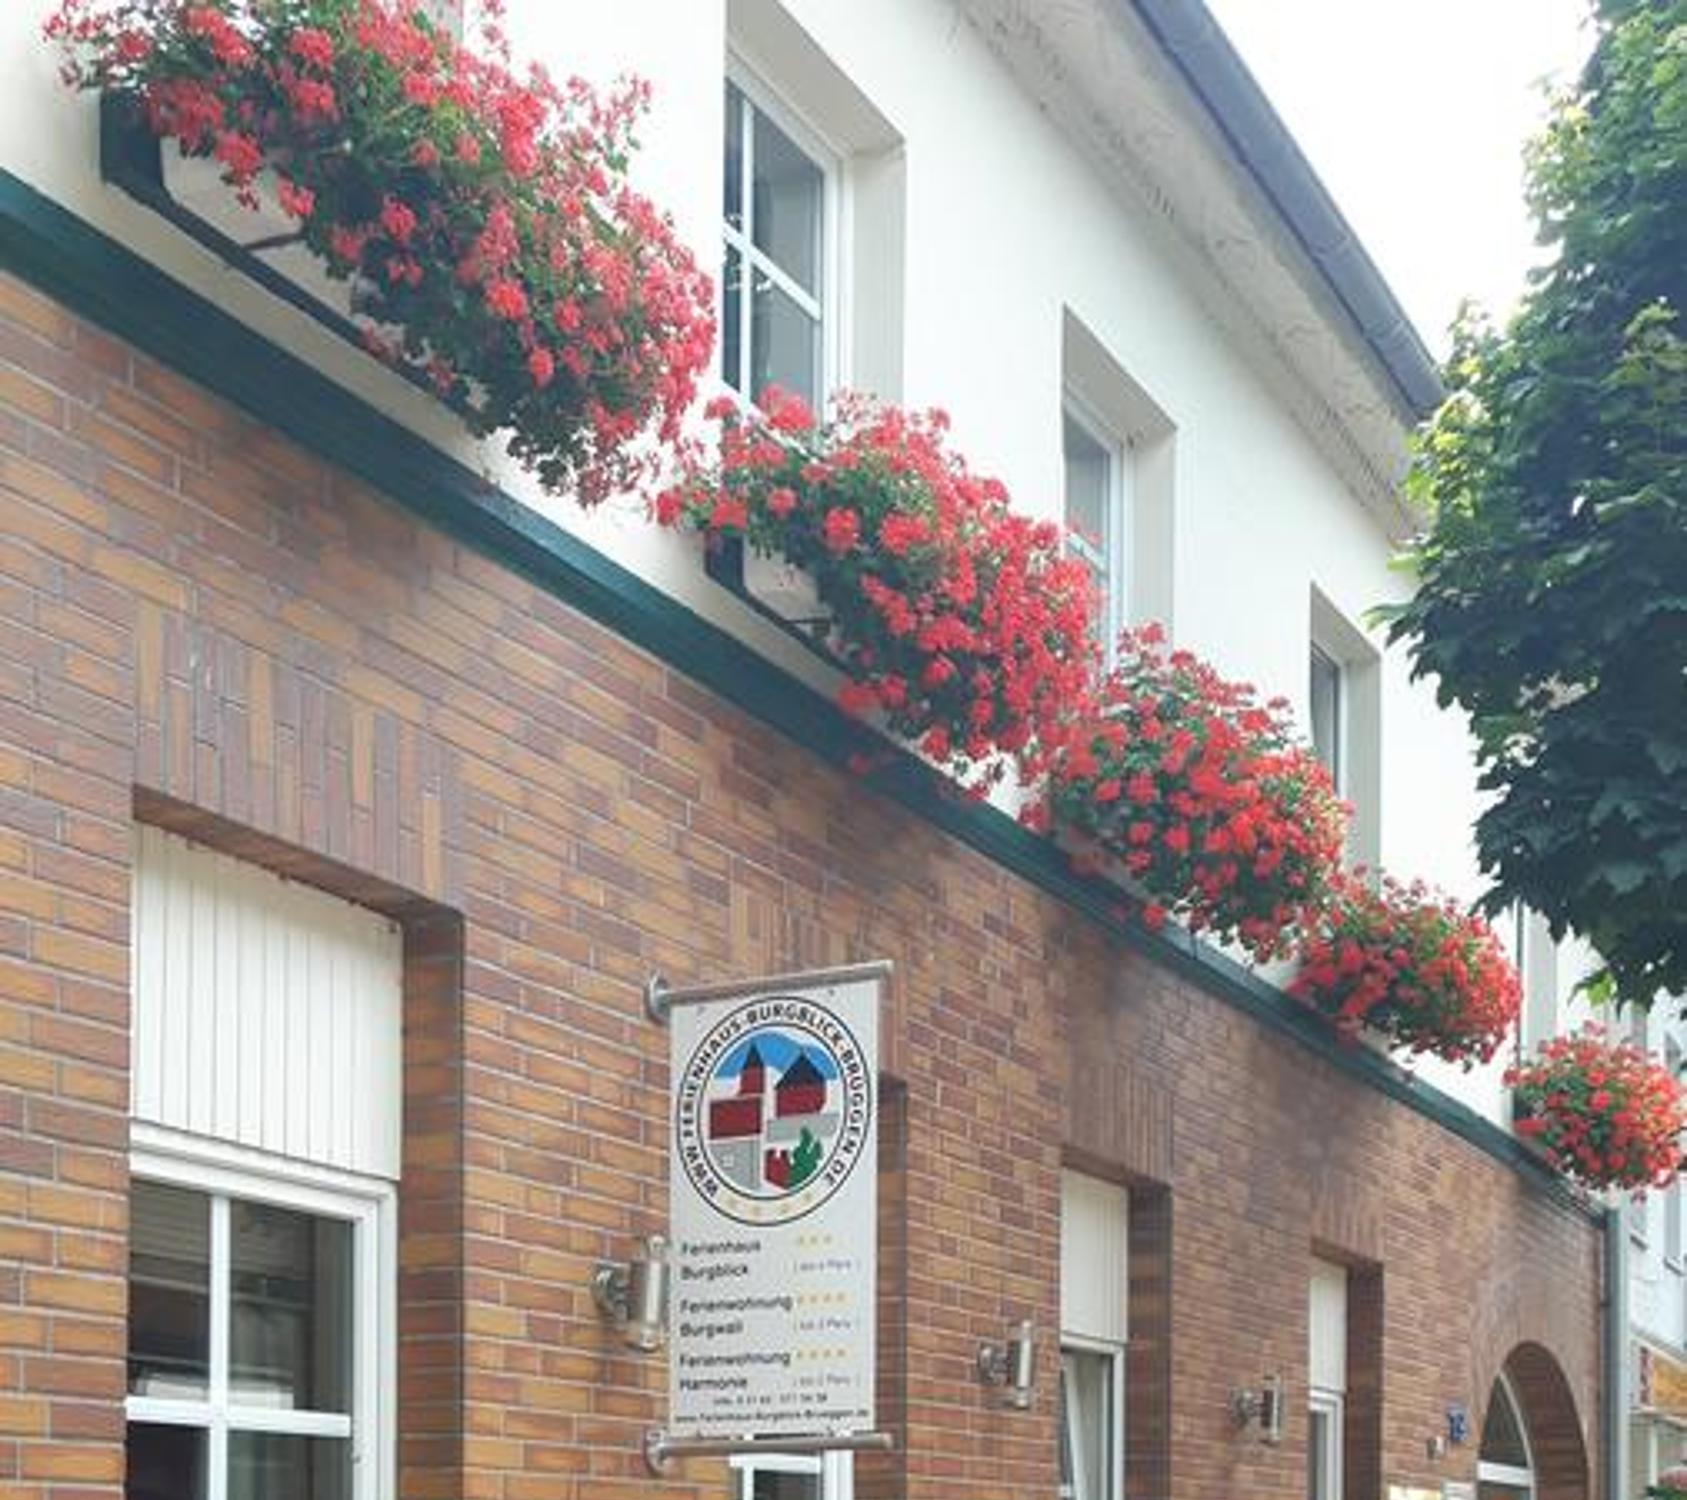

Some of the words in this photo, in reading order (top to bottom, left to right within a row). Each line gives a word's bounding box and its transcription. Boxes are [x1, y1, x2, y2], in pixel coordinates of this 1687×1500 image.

[681, 1240, 761, 1257] Ferienhaus
[681, 1264, 748, 1282] Burgblick
[679, 1296, 793, 1314] Ferienwohnung
[680, 1321, 744, 1340] Burgwall
[679, 1352, 791, 1368] Ferienwohnung
[679, 1376, 748, 1391] Harmonie
